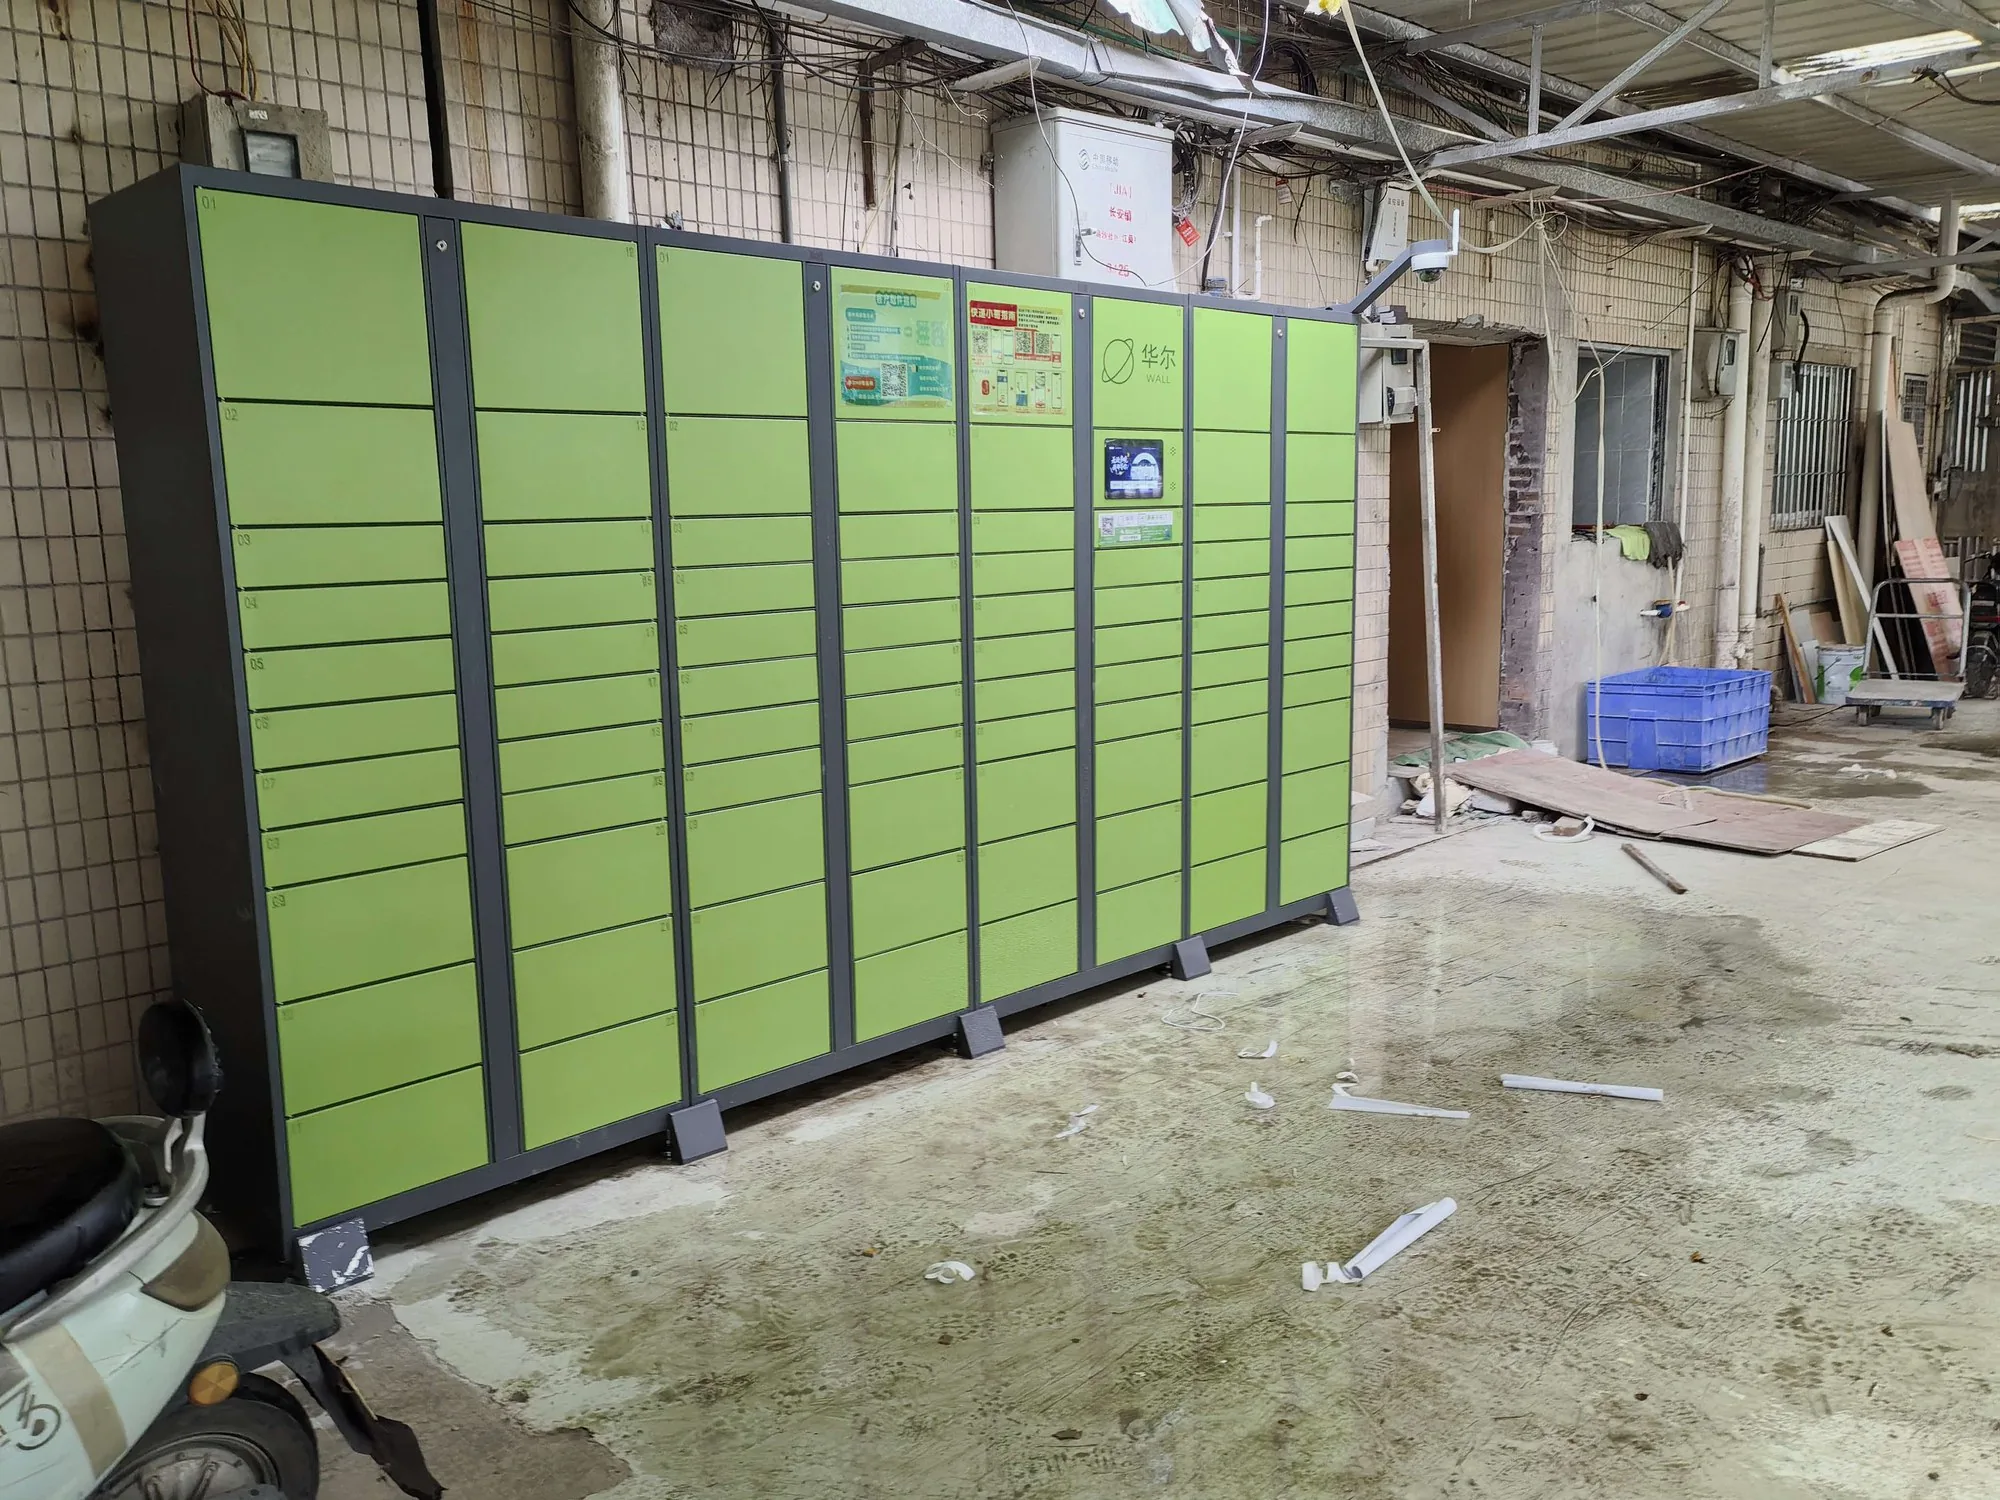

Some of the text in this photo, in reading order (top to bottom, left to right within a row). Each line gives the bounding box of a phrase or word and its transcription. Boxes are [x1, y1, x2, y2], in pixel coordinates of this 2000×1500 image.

[202, 196, 216, 209] 01
[1142, 344, 1176, 370] 华尔
[1147, 374, 1171, 384] WALL
[225, 408, 239, 421] 02
